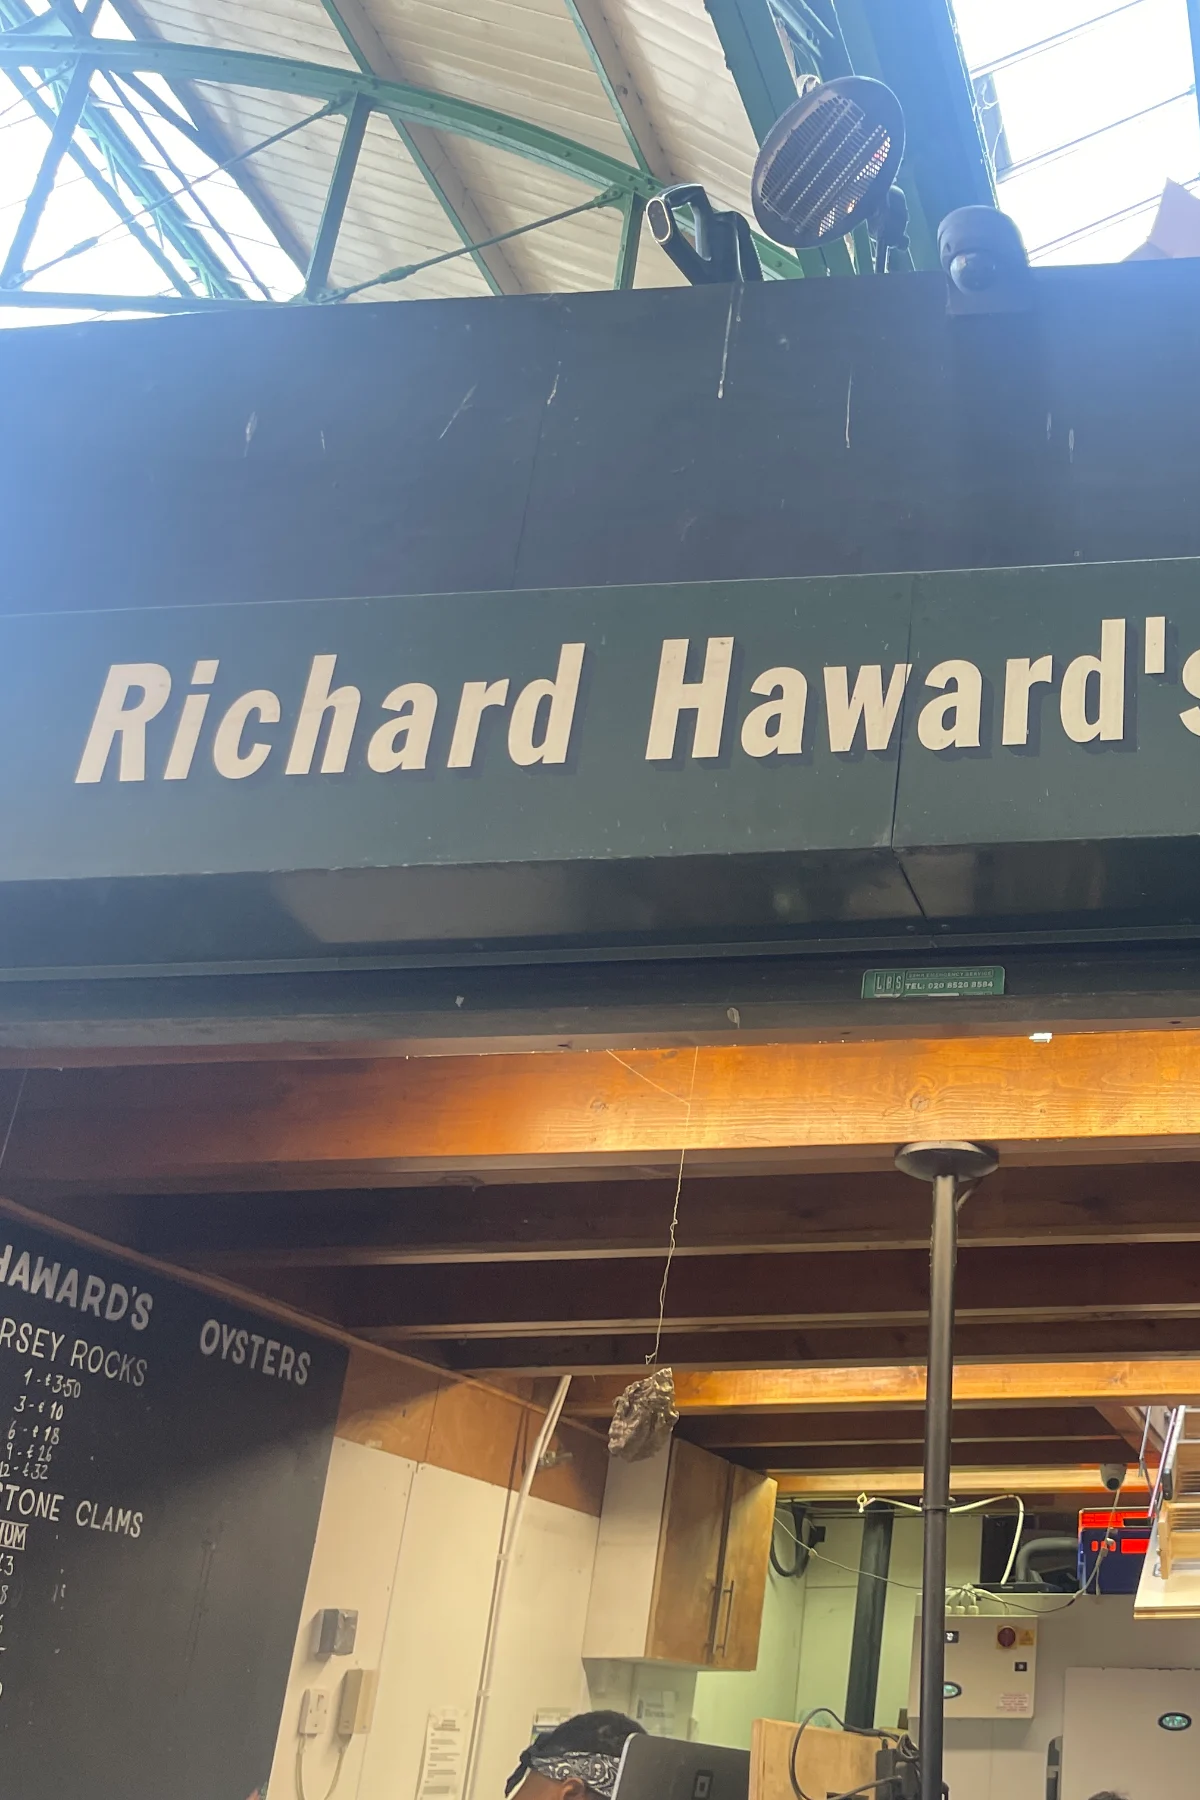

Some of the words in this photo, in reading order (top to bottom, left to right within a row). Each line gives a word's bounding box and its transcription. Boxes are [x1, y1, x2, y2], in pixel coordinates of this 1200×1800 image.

[74, 642, 586, 784] Richard
[927, 982, 945, 990] 020
[70, 1339, 148, 1387] ROCKS
[200, 1318, 312, 1385] OYSTERS
[0, 1482, 65, 1522] TONE
[76, 1500, 144, 1539] CLAMS
